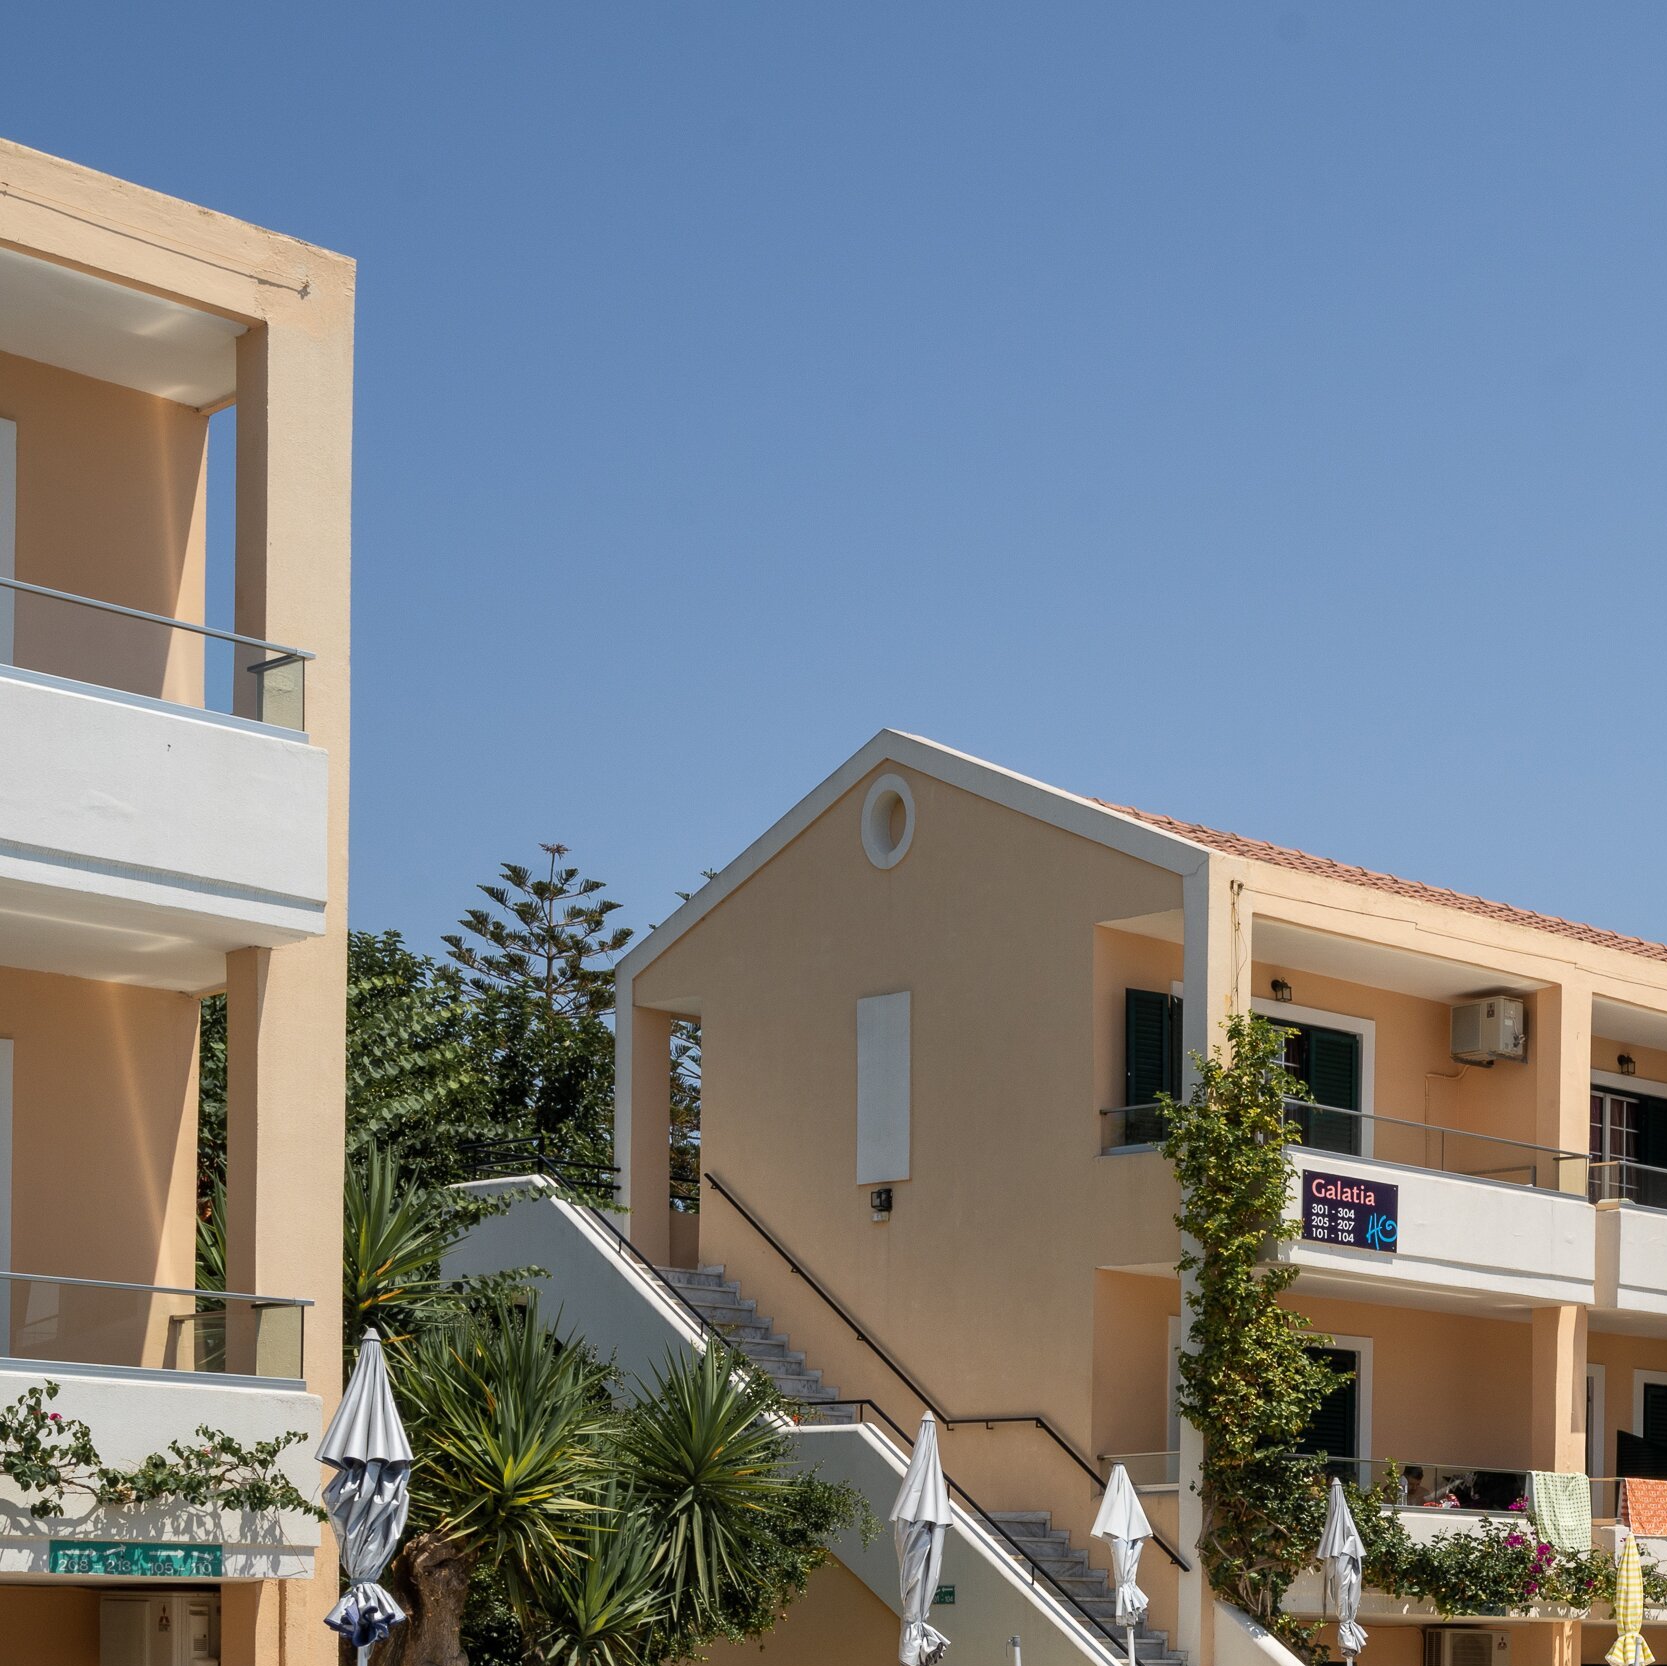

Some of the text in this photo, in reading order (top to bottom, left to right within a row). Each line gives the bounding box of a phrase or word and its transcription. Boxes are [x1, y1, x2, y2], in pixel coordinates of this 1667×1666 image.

[1311, 1179, 1375, 1206] Galatia
[1312, 1204, 1328, 1215] 301
[1337, 1208, 1355, 1219] 304
[1311, 1216, 1329, 1227] 205
[1337, 1220, 1355, 1231] 207
[1311, 1228, 1328, 1239] 101
[1337, 1232, 1354, 1243] 104
[58, 1560, 89, 1571] 208
[106, 1560, 132, 1572] 213
[149, 1562, 174, 1574] 105
[191, 1563, 212, 1574] 110
